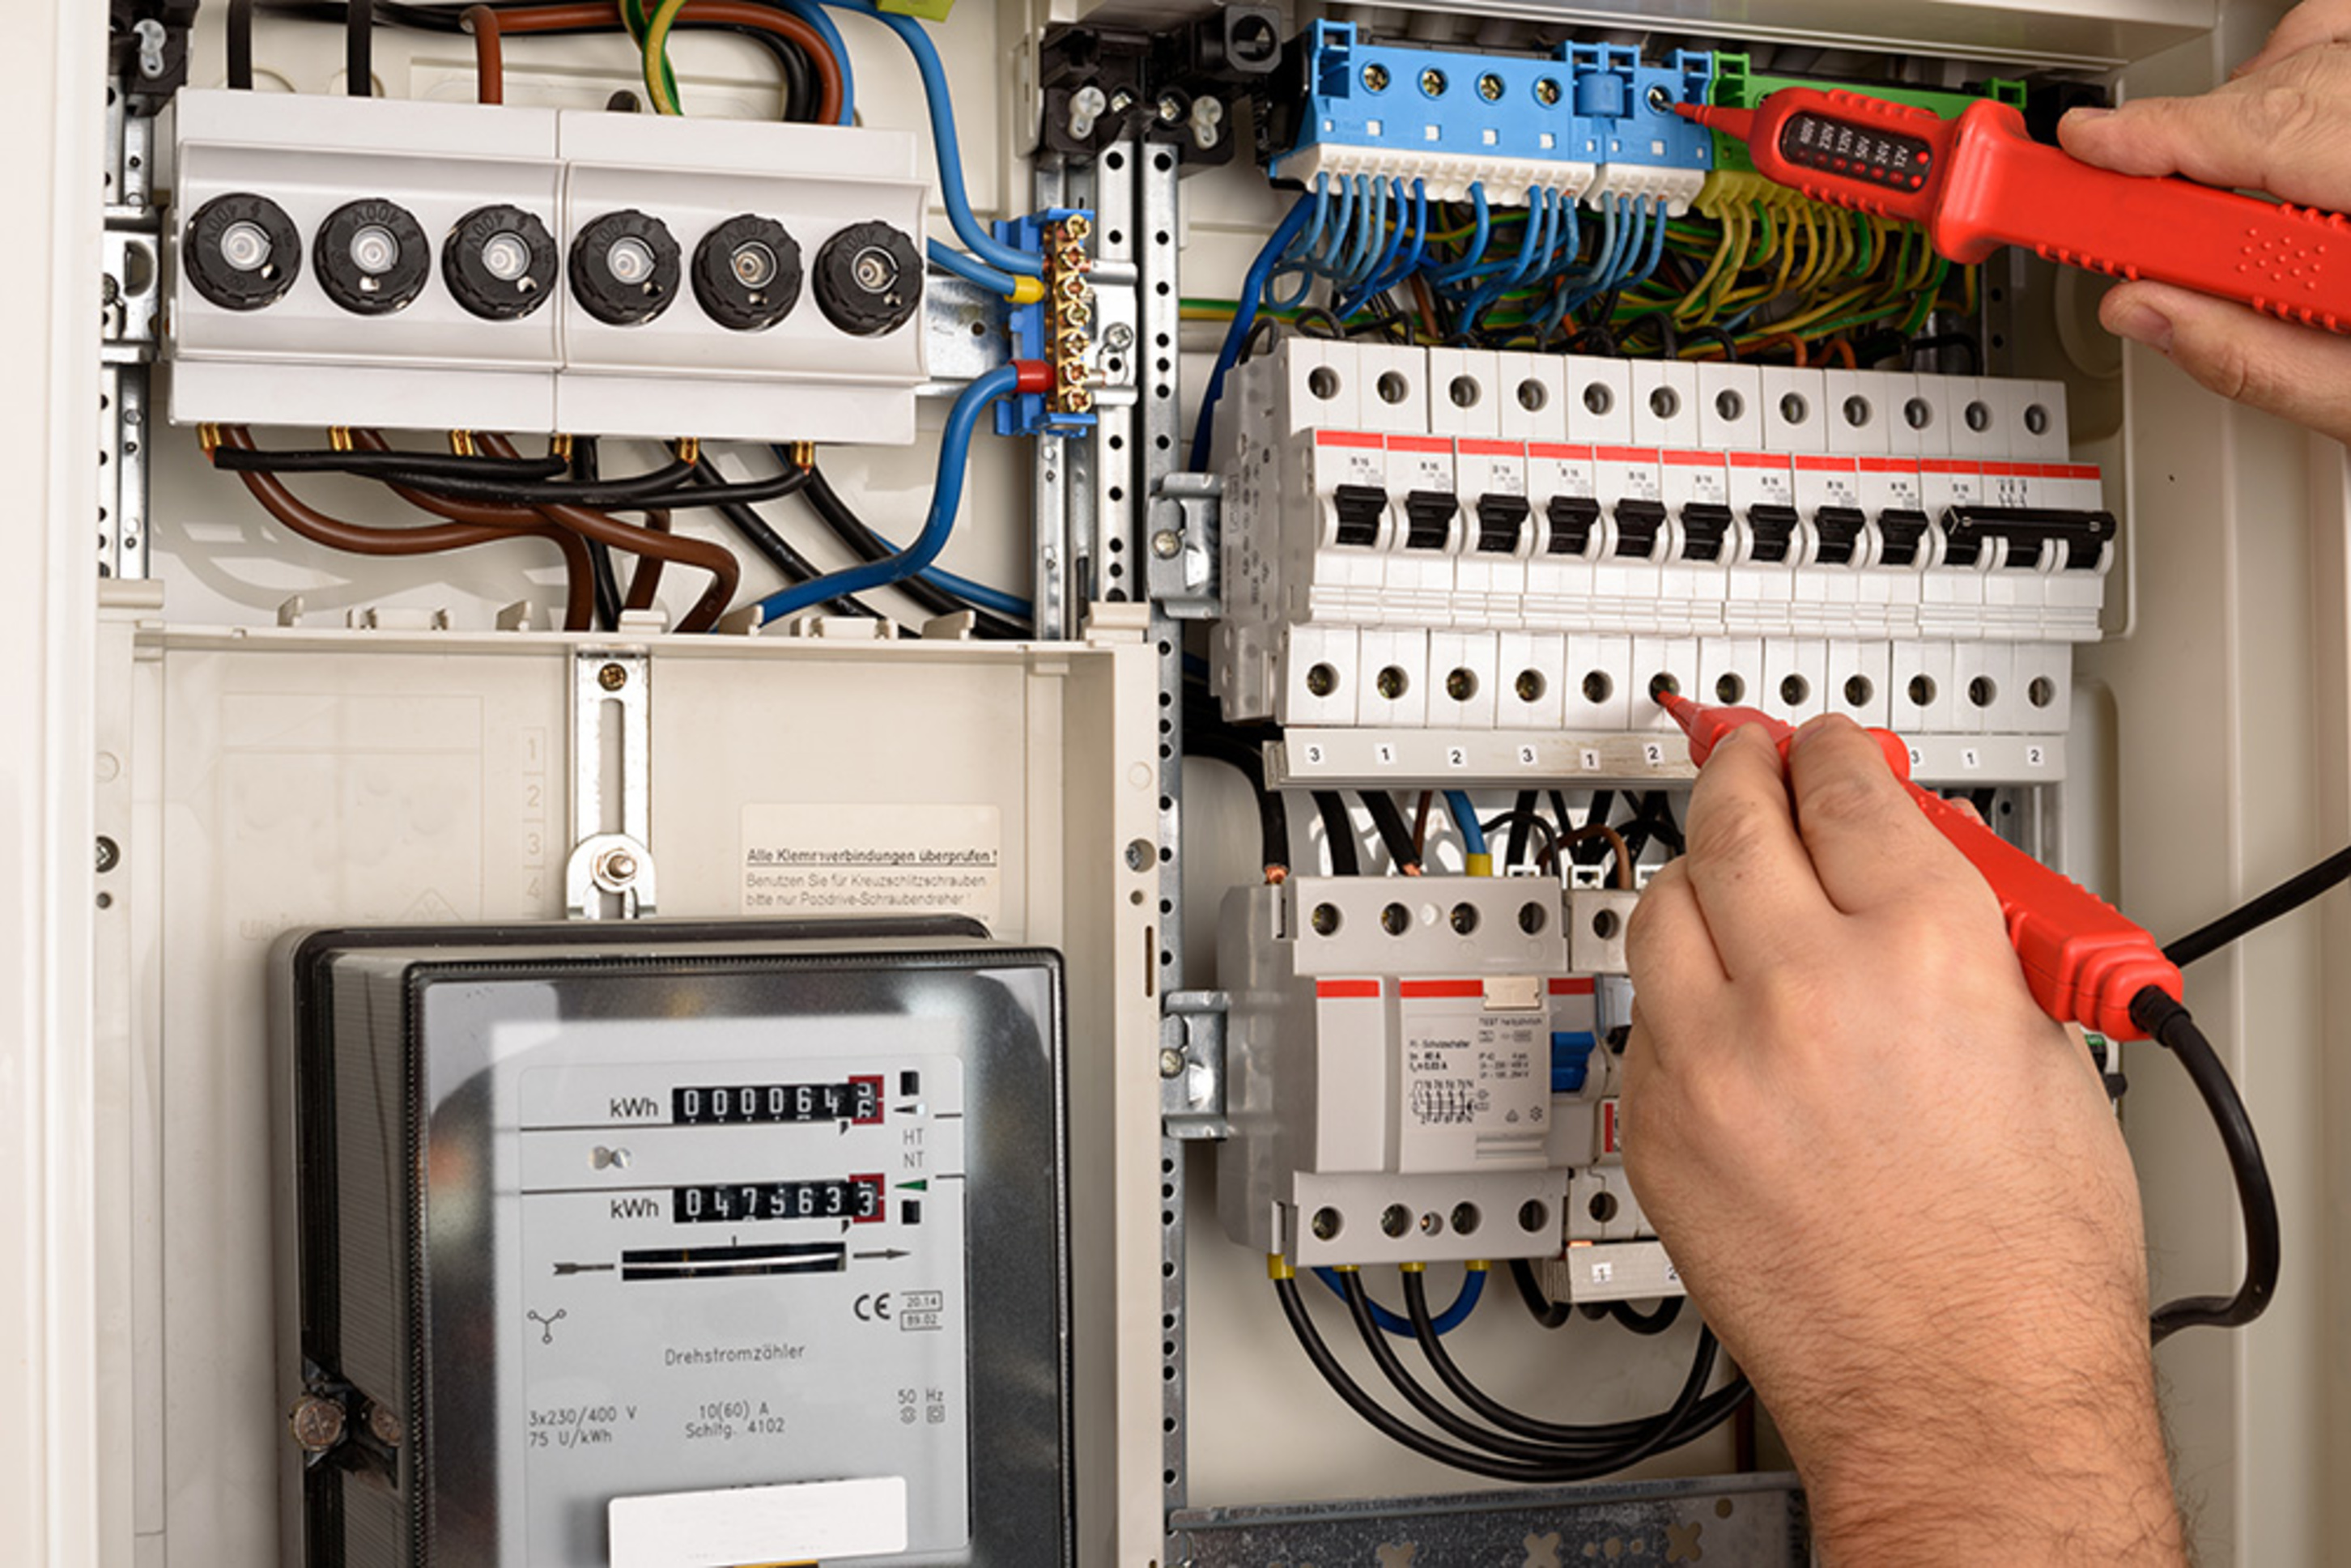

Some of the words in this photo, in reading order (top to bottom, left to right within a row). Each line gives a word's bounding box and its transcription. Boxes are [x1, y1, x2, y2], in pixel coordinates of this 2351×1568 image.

[1309, 747, 1320, 762] 3
[1380, 747, 1390, 762] 1
[1452, 750, 1463, 765] 2
[1522, 749, 1533, 763] 3
[1586, 753, 1595, 767] 1
[1648, 746, 1659, 760] 2
[1966, 752, 1975, 765] 1
[2030, 750, 2040, 763] 2
[526, 785, 542, 808] 2
[527, 832, 542, 856] 3
[747, 850, 773, 863] Alle
[746, 873, 804, 888] Benutzen
[808, 873, 828, 887] Sie
[831, 873, 848, 887] für
[746, 892, 773, 906] bitte
[776, 894, 797, 906] nur
[610, 1096, 658, 1118] kWh
[903, 1128, 924, 1145] HT
[903, 1152, 925, 1169] NT
[610, 1198, 659, 1220] kWh
[665, 1344, 806, 1366] Drehstromzähler
[898, 1389, 916, 1405] 50
[925, 1388, 945, 1404] Hz
[529, 1406, 618, 1428] 3x230/400
[627, 1405, 638, 1421] V
[699, 1400, 750, 1421] 10(60)
[759, 1401, 769, 1416] A
[747, 1417, 785, 1434] 4102
[529, 1430, 550, 1447] 75
[559, 1428, 613, 1450] U/kWh
